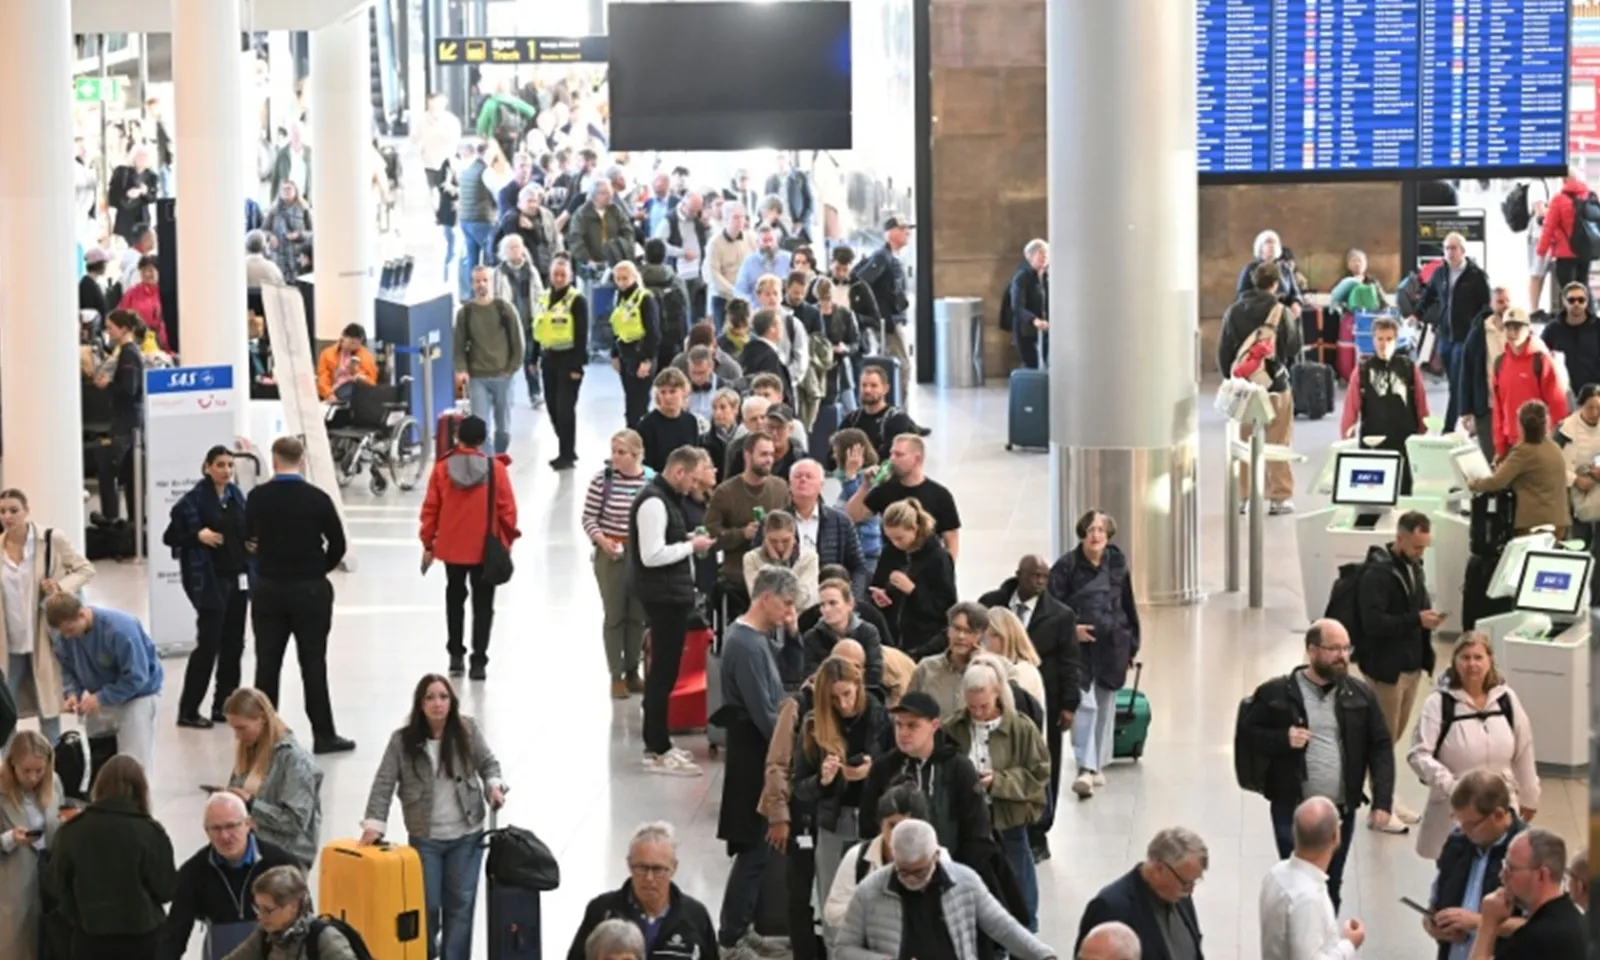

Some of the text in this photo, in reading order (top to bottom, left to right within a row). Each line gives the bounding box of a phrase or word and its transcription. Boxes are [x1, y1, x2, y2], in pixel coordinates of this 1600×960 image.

[491, 38, 516, 50] Spor
[492, 49, 521, 61] Track
[527, 39, 536, 60] 1
[167, 372, 197, 387] SAS
